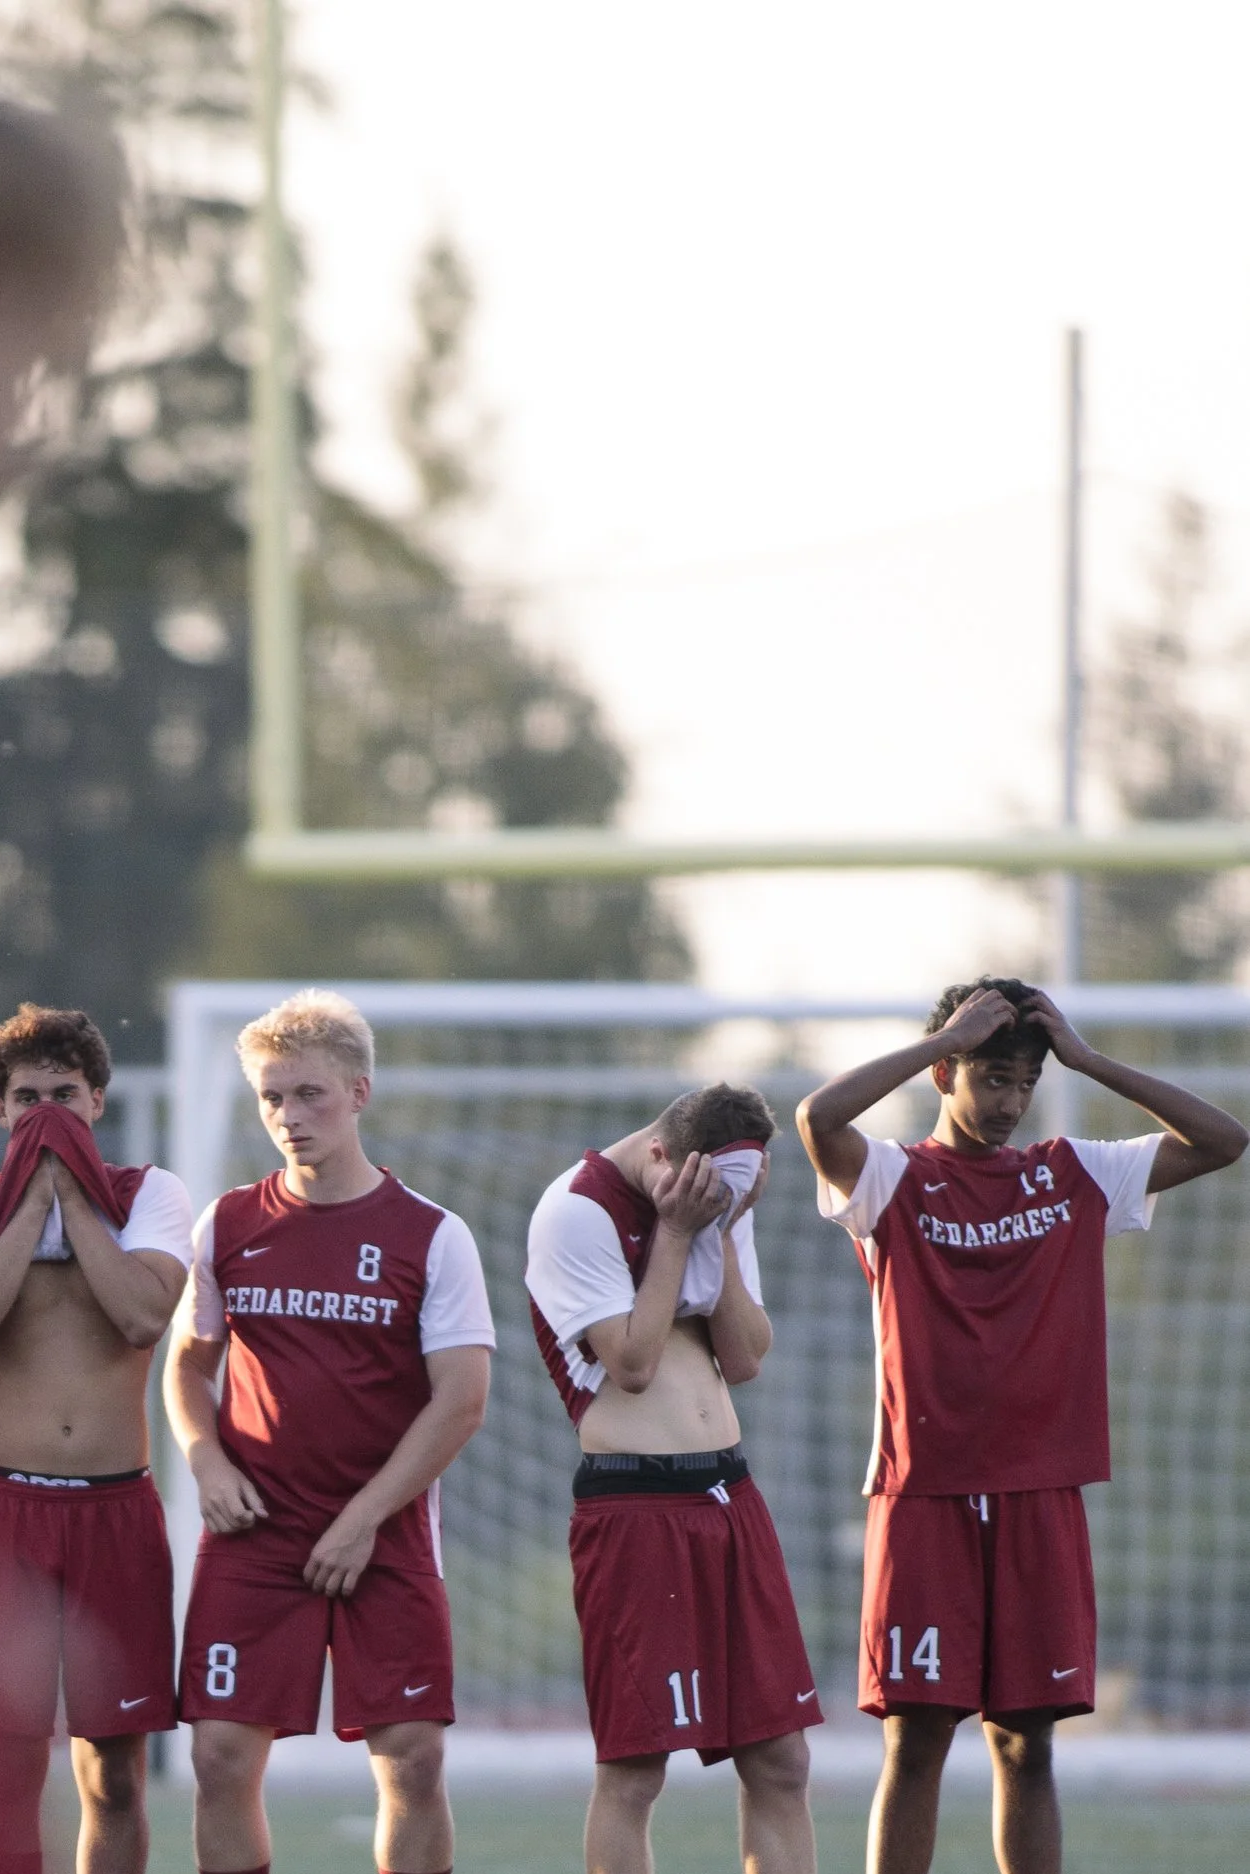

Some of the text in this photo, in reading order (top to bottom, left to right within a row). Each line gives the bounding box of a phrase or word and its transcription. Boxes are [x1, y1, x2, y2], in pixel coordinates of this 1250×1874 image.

[1020, 1164, 1055, 1195] 14
[918, 1198, 1071, 1248] CEDARCREST
[357, 1243, 382, 1282] 8
[225, 1287, 399, 1325] CEDARCREST
[672, 1452, 718, 1471] PUMA
[206, 1643, 237, 1697] 8
[889, 1625, 941, 1681] 14
